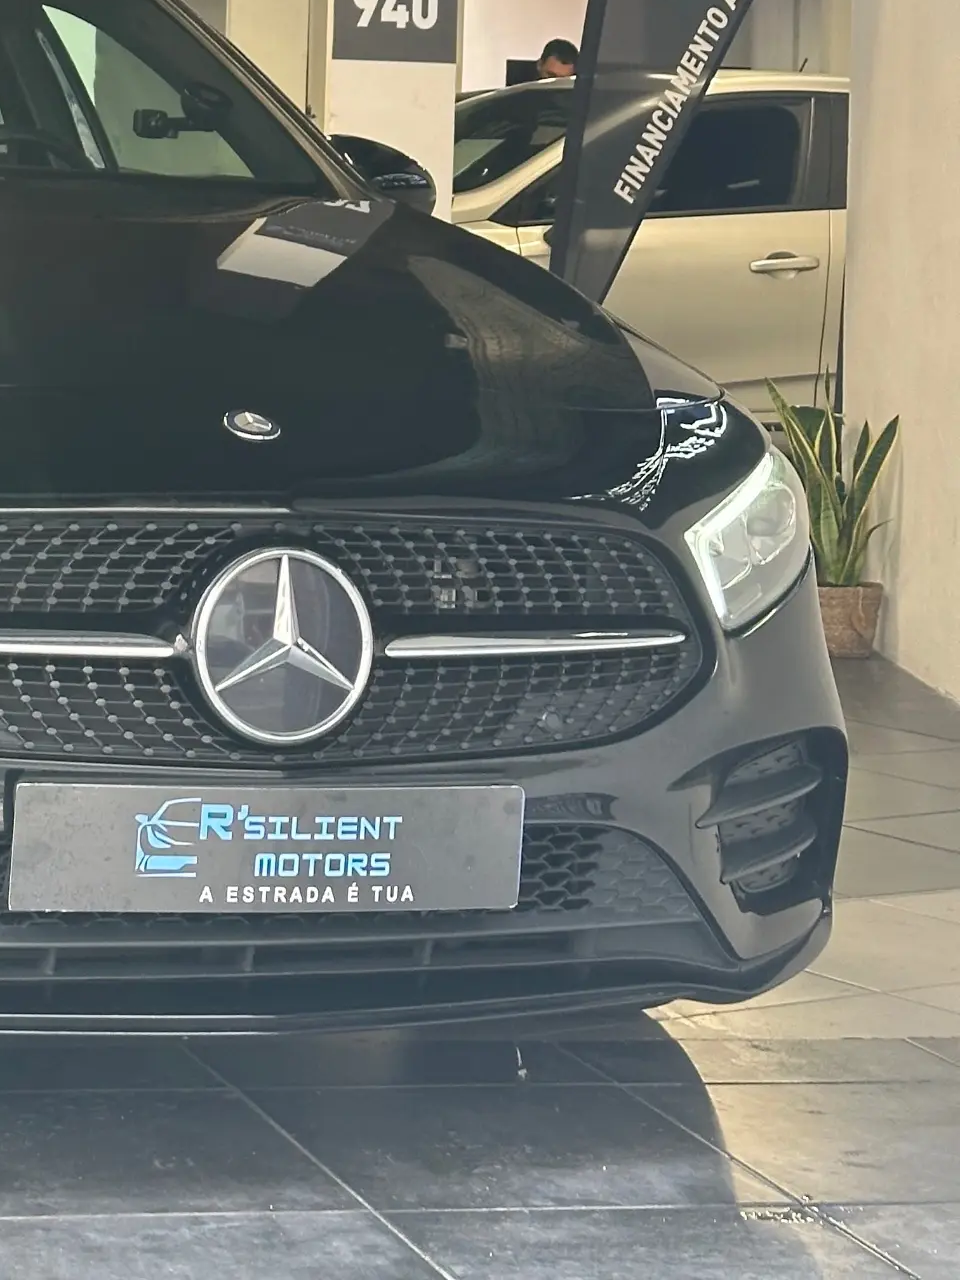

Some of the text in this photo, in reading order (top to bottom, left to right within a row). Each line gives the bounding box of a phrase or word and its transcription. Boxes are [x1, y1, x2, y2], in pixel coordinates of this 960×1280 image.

[613, 7, 729, 205] FINANCIAMENTO
[198, 803, 403, 841] R'SILIENT
[254, 852, 391, 878] MOTORS
[199, 881, 415, 903] A ESTRADA É TUA
